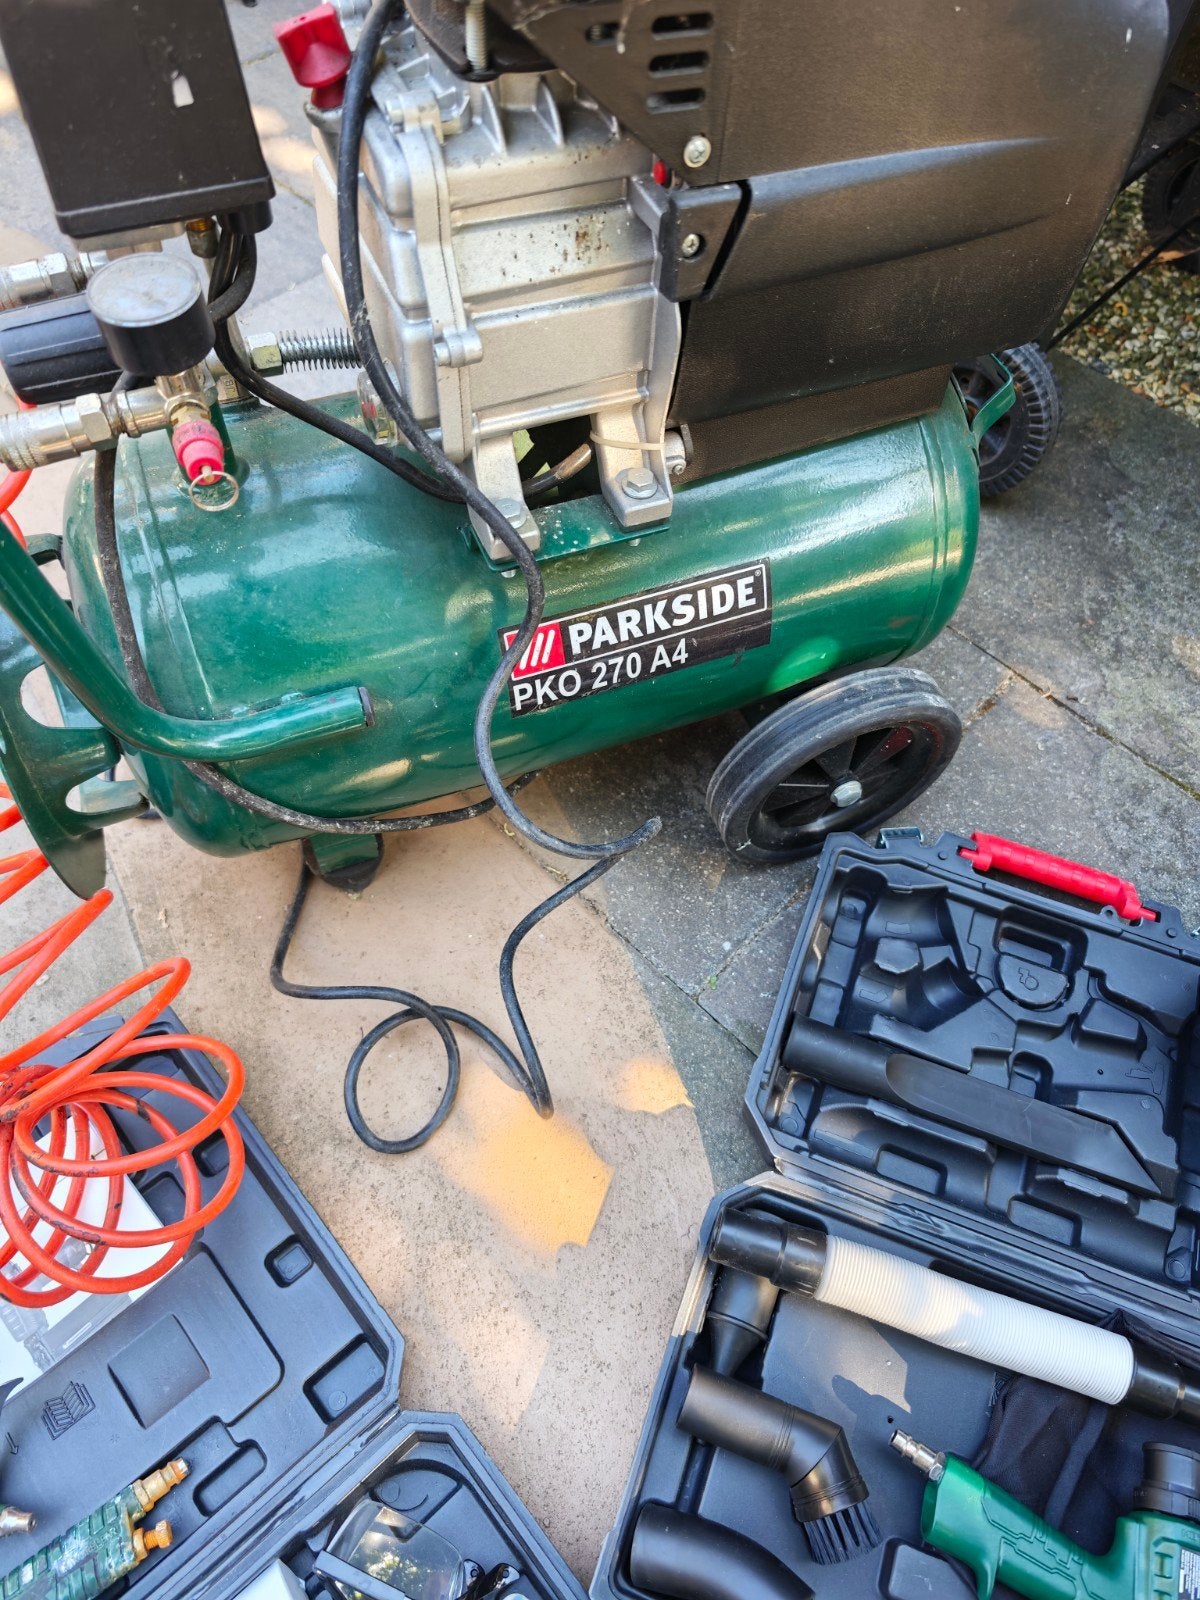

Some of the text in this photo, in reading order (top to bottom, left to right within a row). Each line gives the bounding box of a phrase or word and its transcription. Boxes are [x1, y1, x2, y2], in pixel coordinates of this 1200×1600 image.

[568, 575, 757, 655] PARKSIDE
[513, 638, 689, 711] PKO 270 A4
